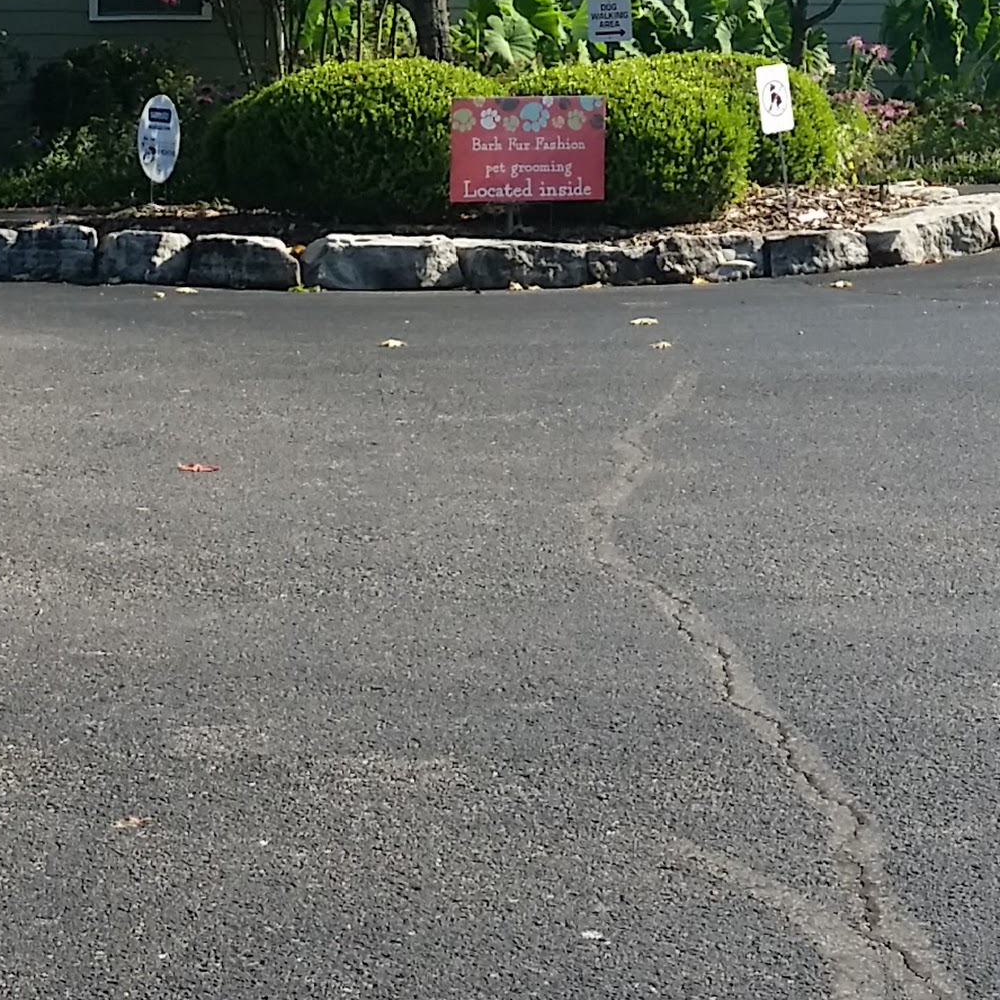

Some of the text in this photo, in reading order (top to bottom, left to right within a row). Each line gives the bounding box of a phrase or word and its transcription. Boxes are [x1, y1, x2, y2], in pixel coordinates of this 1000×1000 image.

[600, 3, 617, 11] DOG
[590, 11, 629, 20] WALKING
[600, 20, 620, 28] AREA
[472, 136, 586, 151] Bark Fur Fashion
[485, 161, 572, 178] pet grooming
[463, 177, 592, 198] Located inside
